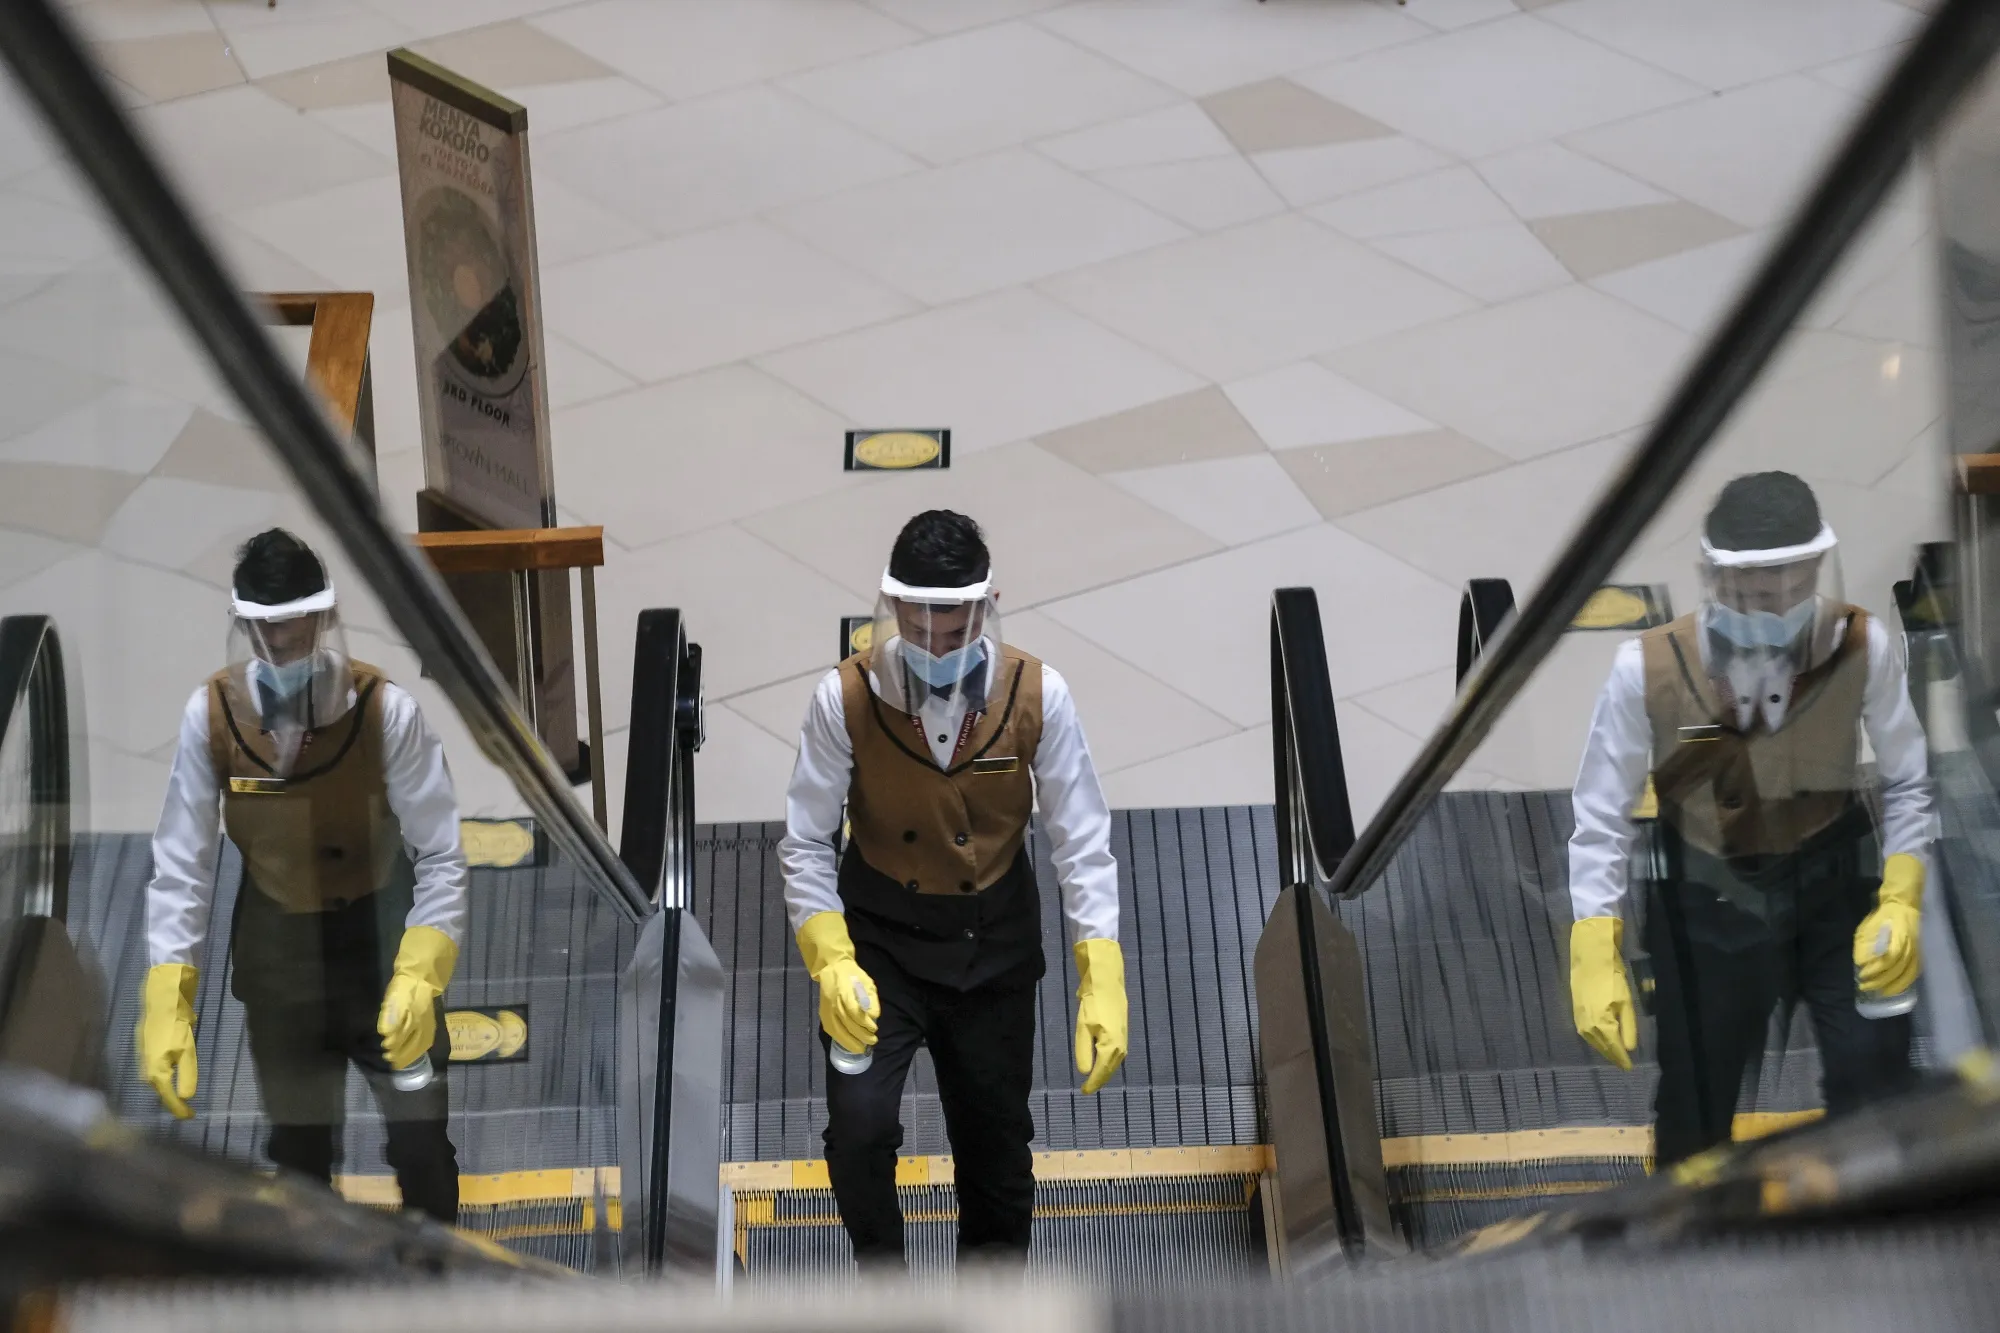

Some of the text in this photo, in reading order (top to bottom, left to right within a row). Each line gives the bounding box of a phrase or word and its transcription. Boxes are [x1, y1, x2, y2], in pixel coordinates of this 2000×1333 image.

[419, 115, 489, 162] KOKORO
[423, 97, 480, 139] MENYA
[471, 395, 510, 428] FLOOR
